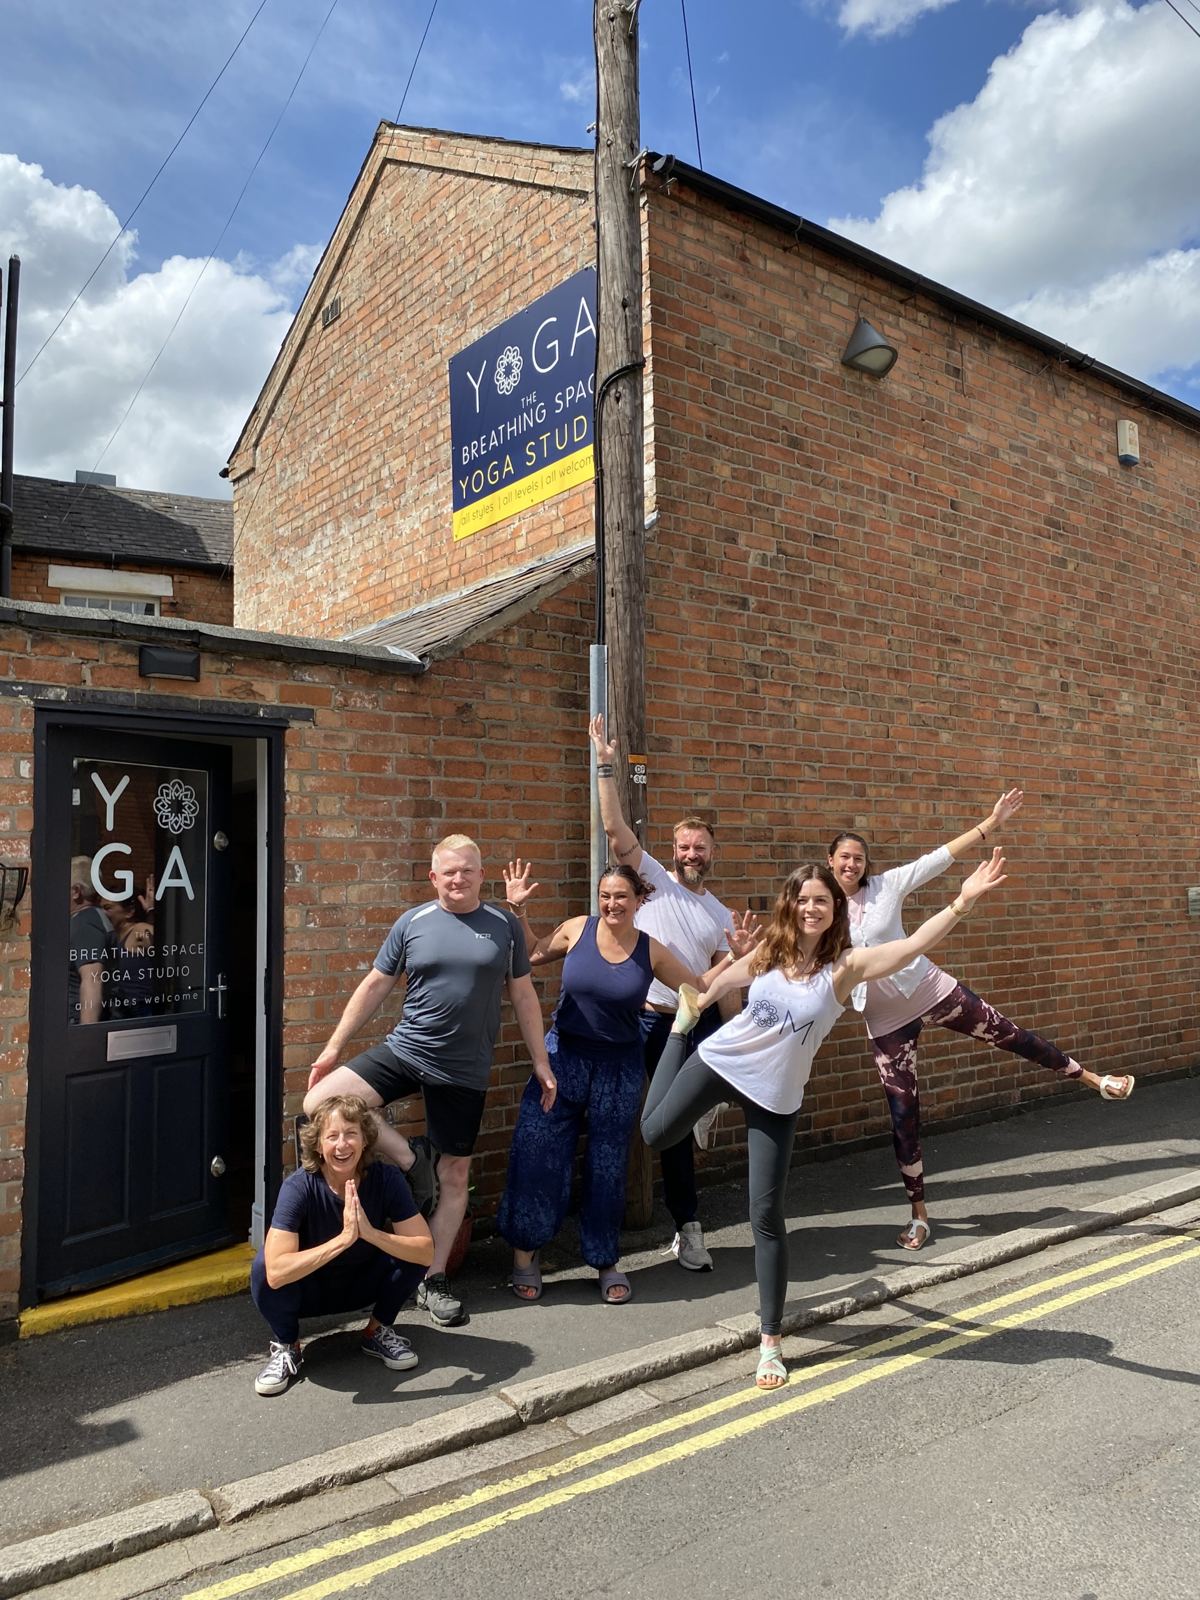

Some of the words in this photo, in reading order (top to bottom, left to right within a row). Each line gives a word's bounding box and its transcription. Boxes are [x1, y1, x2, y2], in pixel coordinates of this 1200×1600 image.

[521, 391, 537, 409] THE
[462, 402, 546, 465] BREATHING
[554, 373, 594, 413] SPAC
[460, 454, 514, 499] YOGA
[525, 415, 588, 466] STUD
[472, 503, 494, 522] styles
[502, 490, 513, 506] all
[514, 480, 539, 497] levels
[546, 470, 556, 486] all
[559, 455, 594, 478] welcom
[135, 931, 150, 939] THE
[69, 946, 156, 961] BREATHING
[162, 943, 204, 957] SPACE
[91, 970, 131, 983] YOGA
[138, 965, 190, 980] STUDIO
[75, 1000, 93, 1011] all
[101, 997, 137, 1009] vibes
[144, 992, 199, 1005] welcome
